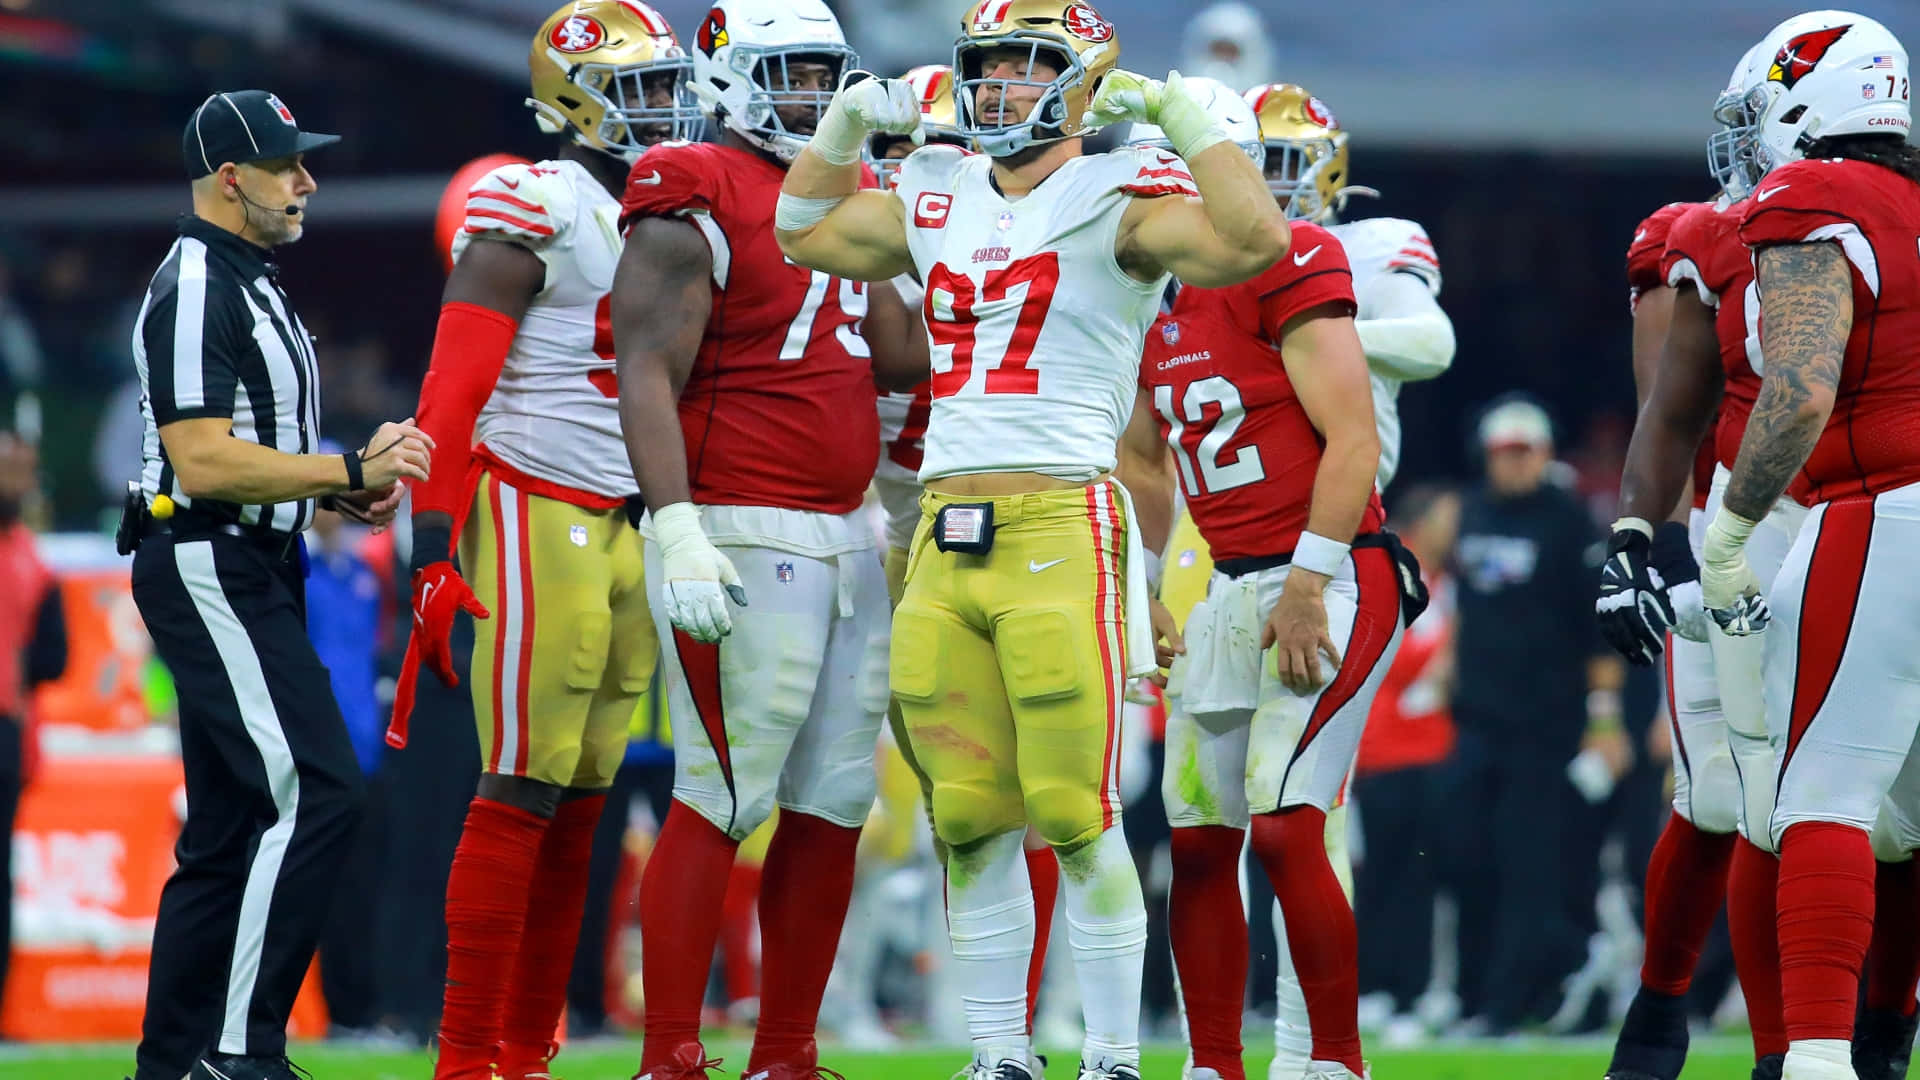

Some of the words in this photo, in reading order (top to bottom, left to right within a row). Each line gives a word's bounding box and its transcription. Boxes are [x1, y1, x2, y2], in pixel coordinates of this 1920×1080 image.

[917, 194, 949, 219] C
[971, 247, 1011, 263] 49ERS
[778, 255, 871, 360] 79
[924, 252, 1060, 400] 97
[1157, 351, 1211, 371] CARDINALS
[1154, 375, 1267, 497] 12
